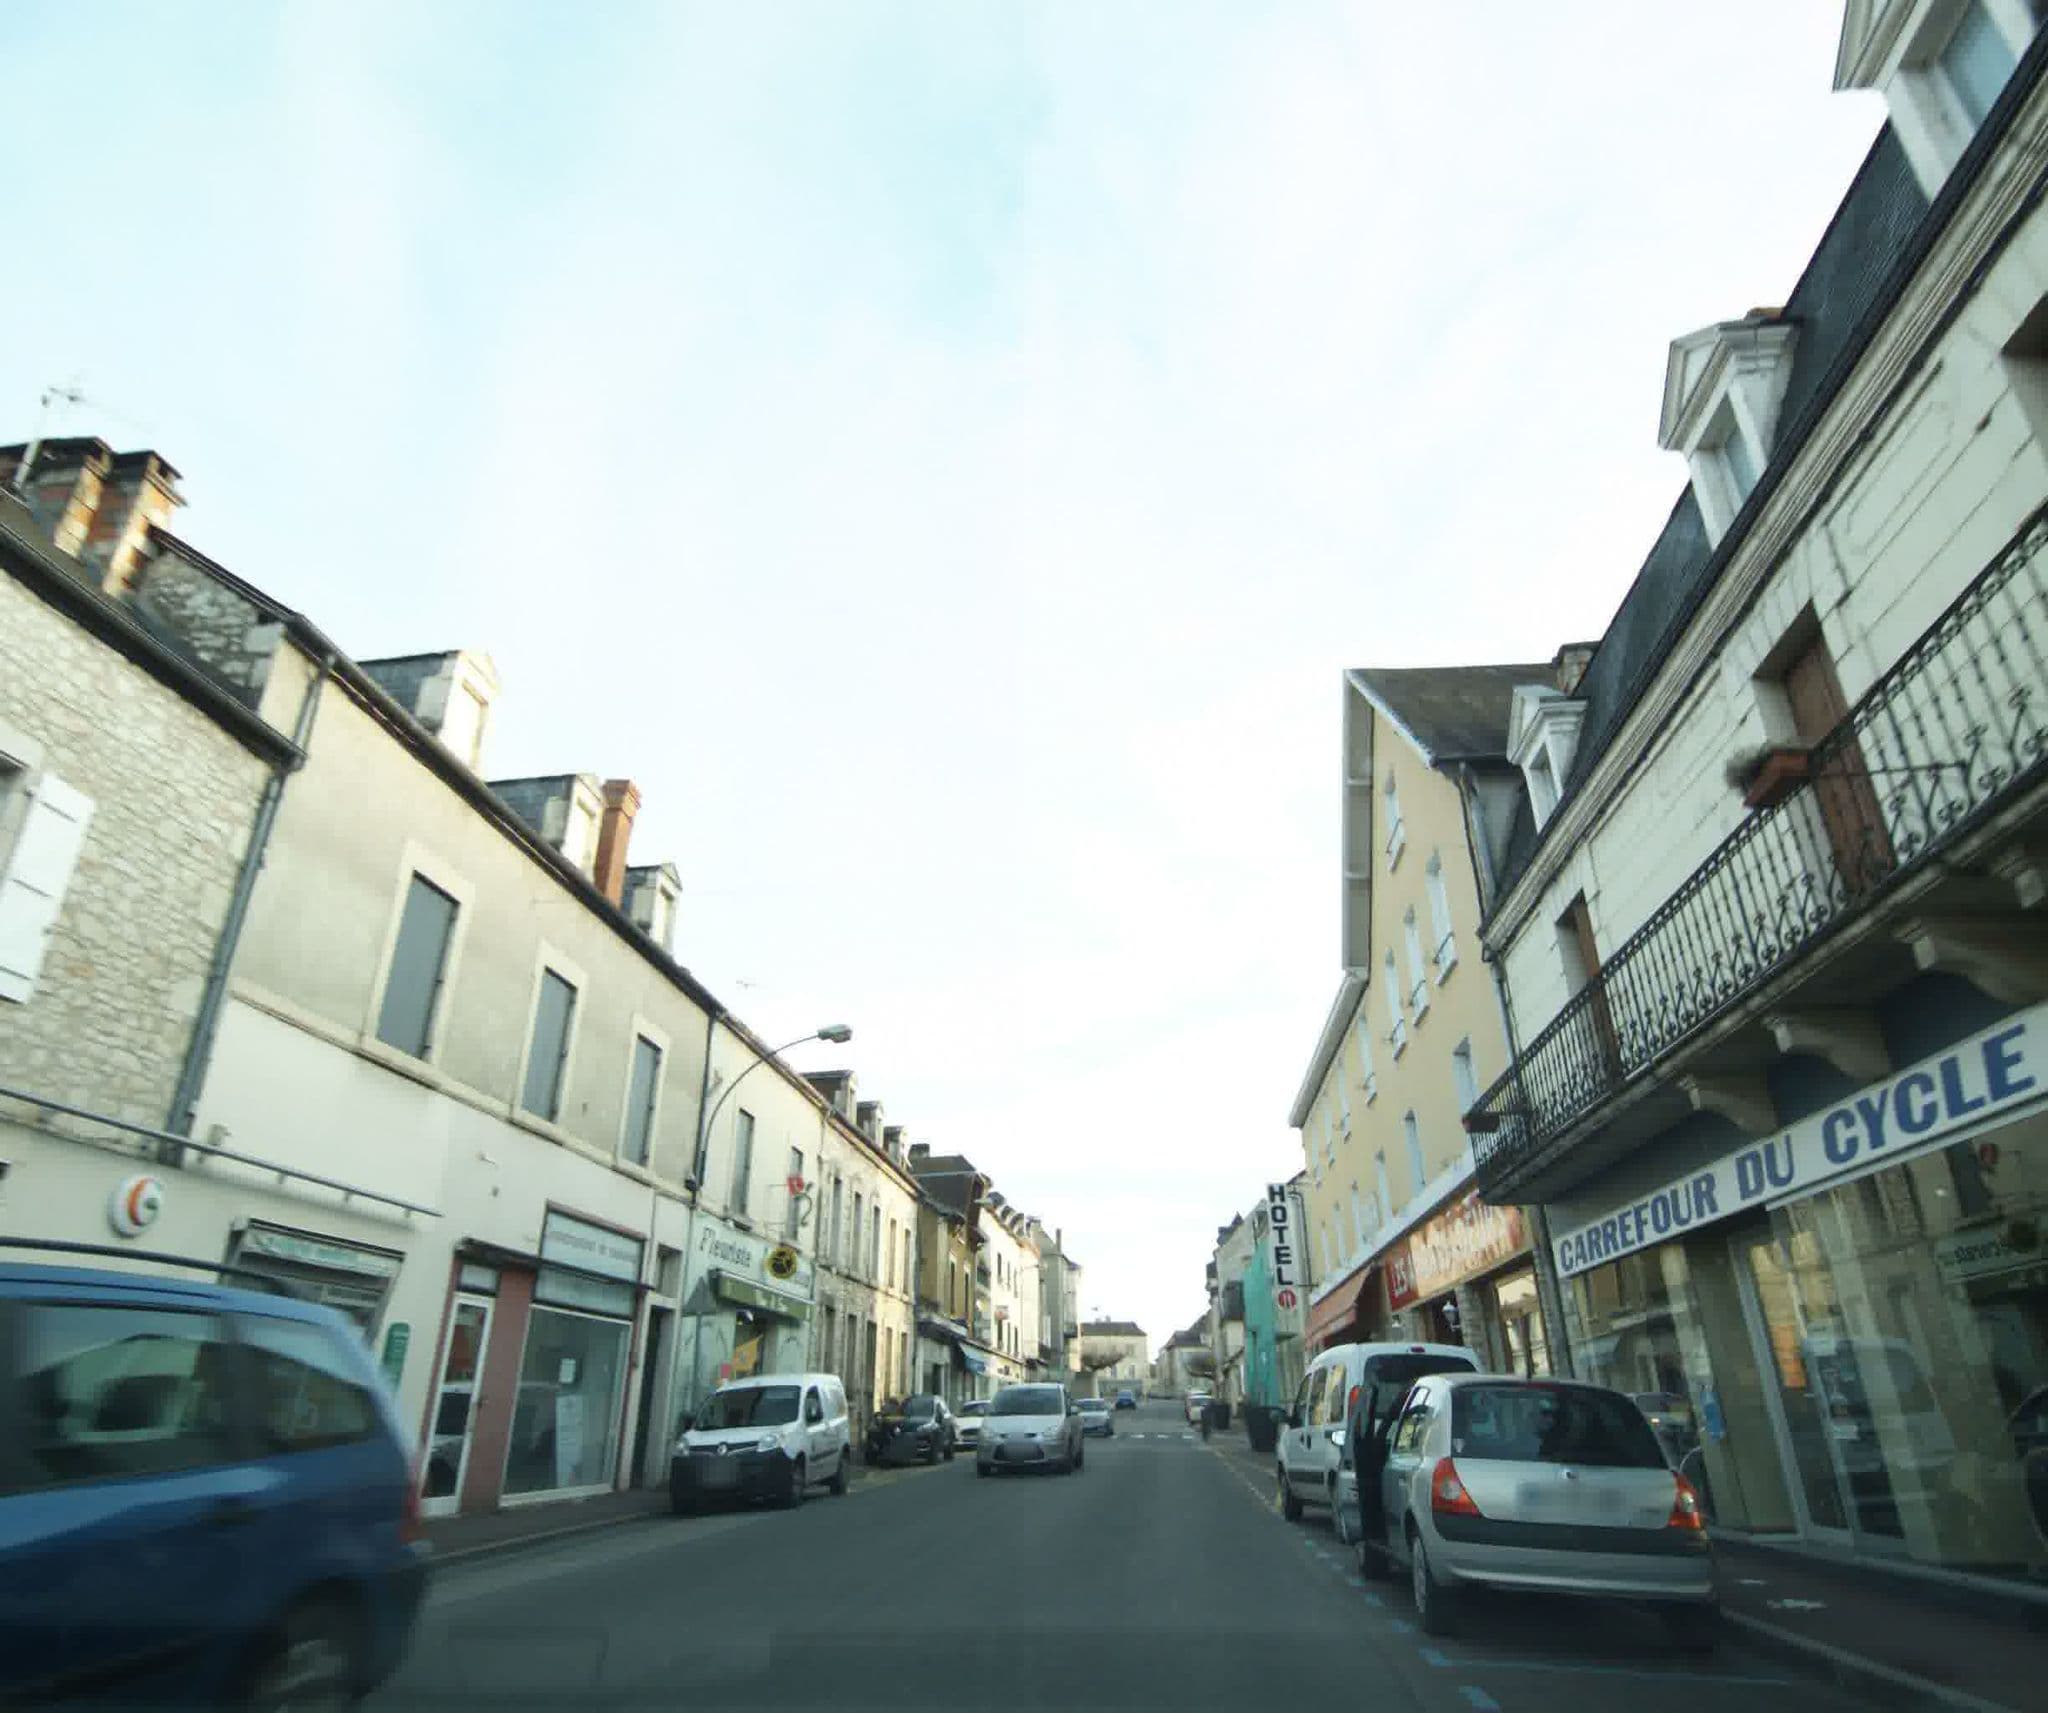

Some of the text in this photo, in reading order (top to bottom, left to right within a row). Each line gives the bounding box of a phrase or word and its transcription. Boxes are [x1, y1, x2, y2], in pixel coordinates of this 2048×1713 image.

[1267, 1183, 1294, 1286] HOTEL
[1559, 1172, 1719, 1272] CARREFOUR
[1734, 1133, 1795, 1201] DU
[1821, 1023, 2037, 1165] CYCLE
